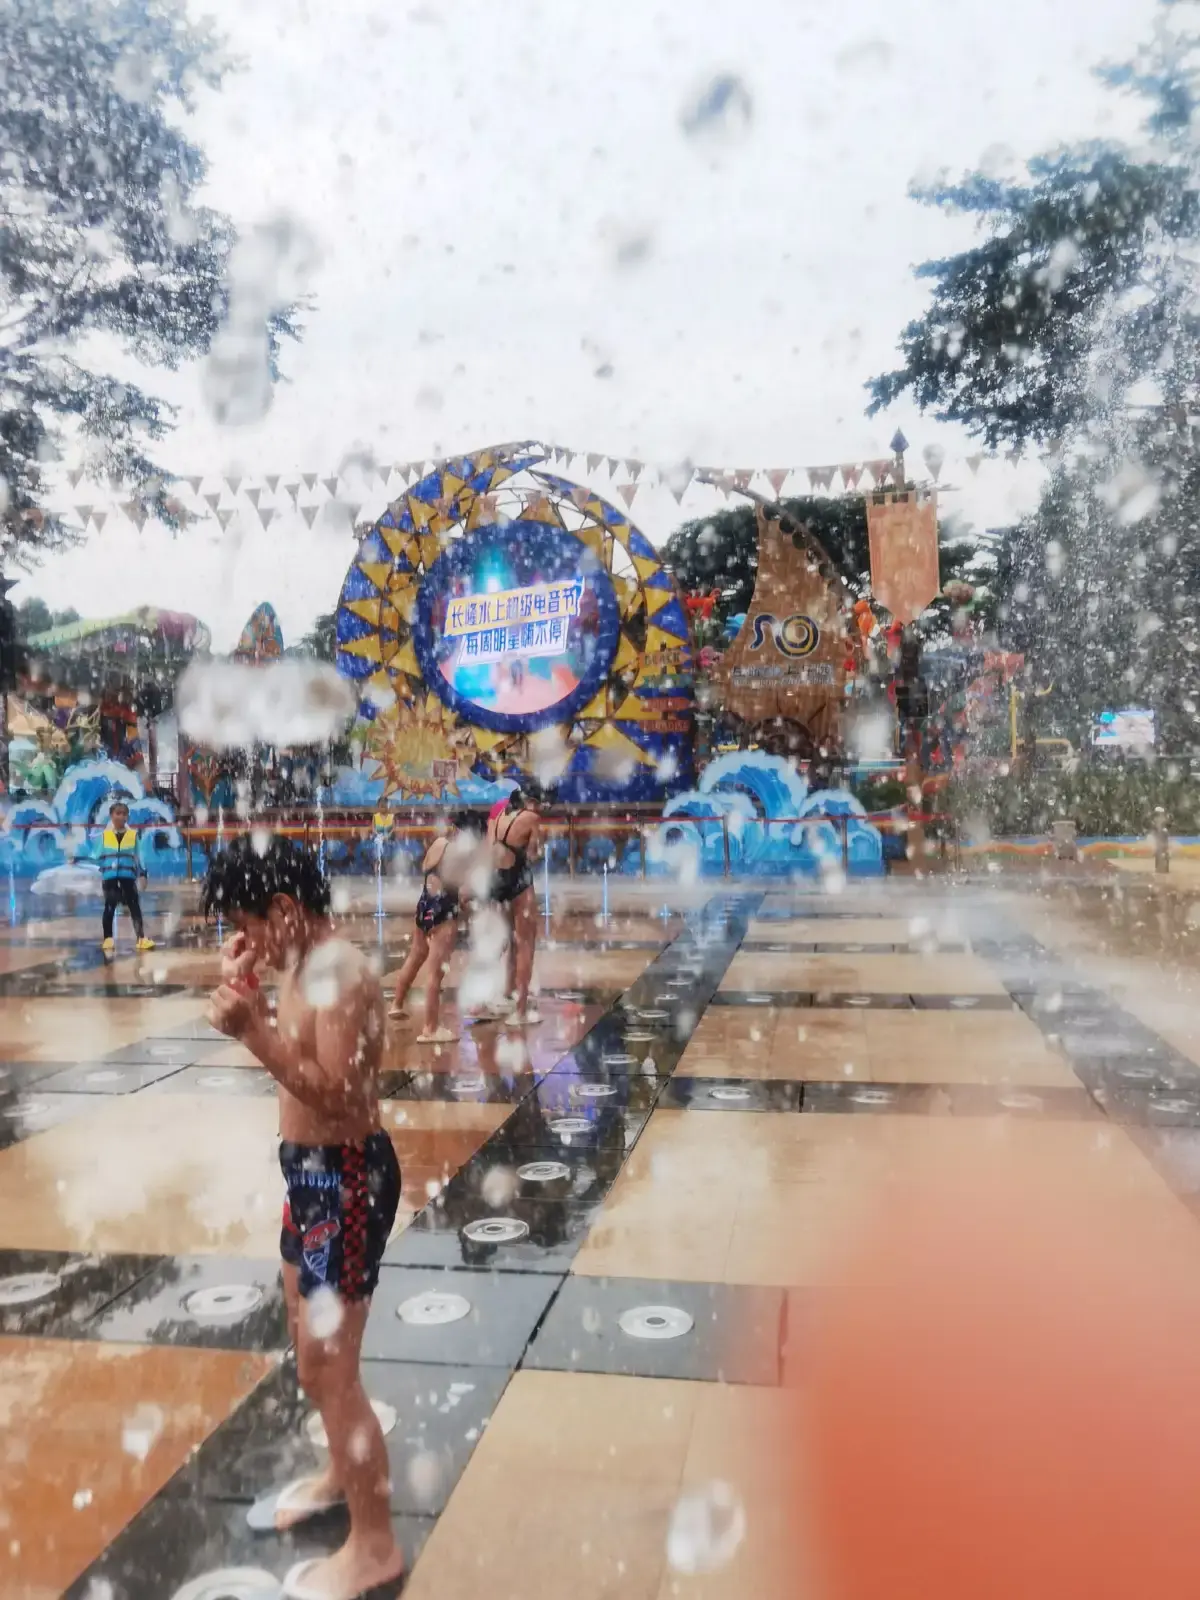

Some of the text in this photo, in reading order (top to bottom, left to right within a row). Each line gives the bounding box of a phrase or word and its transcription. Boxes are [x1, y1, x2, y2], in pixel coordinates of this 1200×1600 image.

[452, 587, 577, 628] 长隆水上超级电音节
